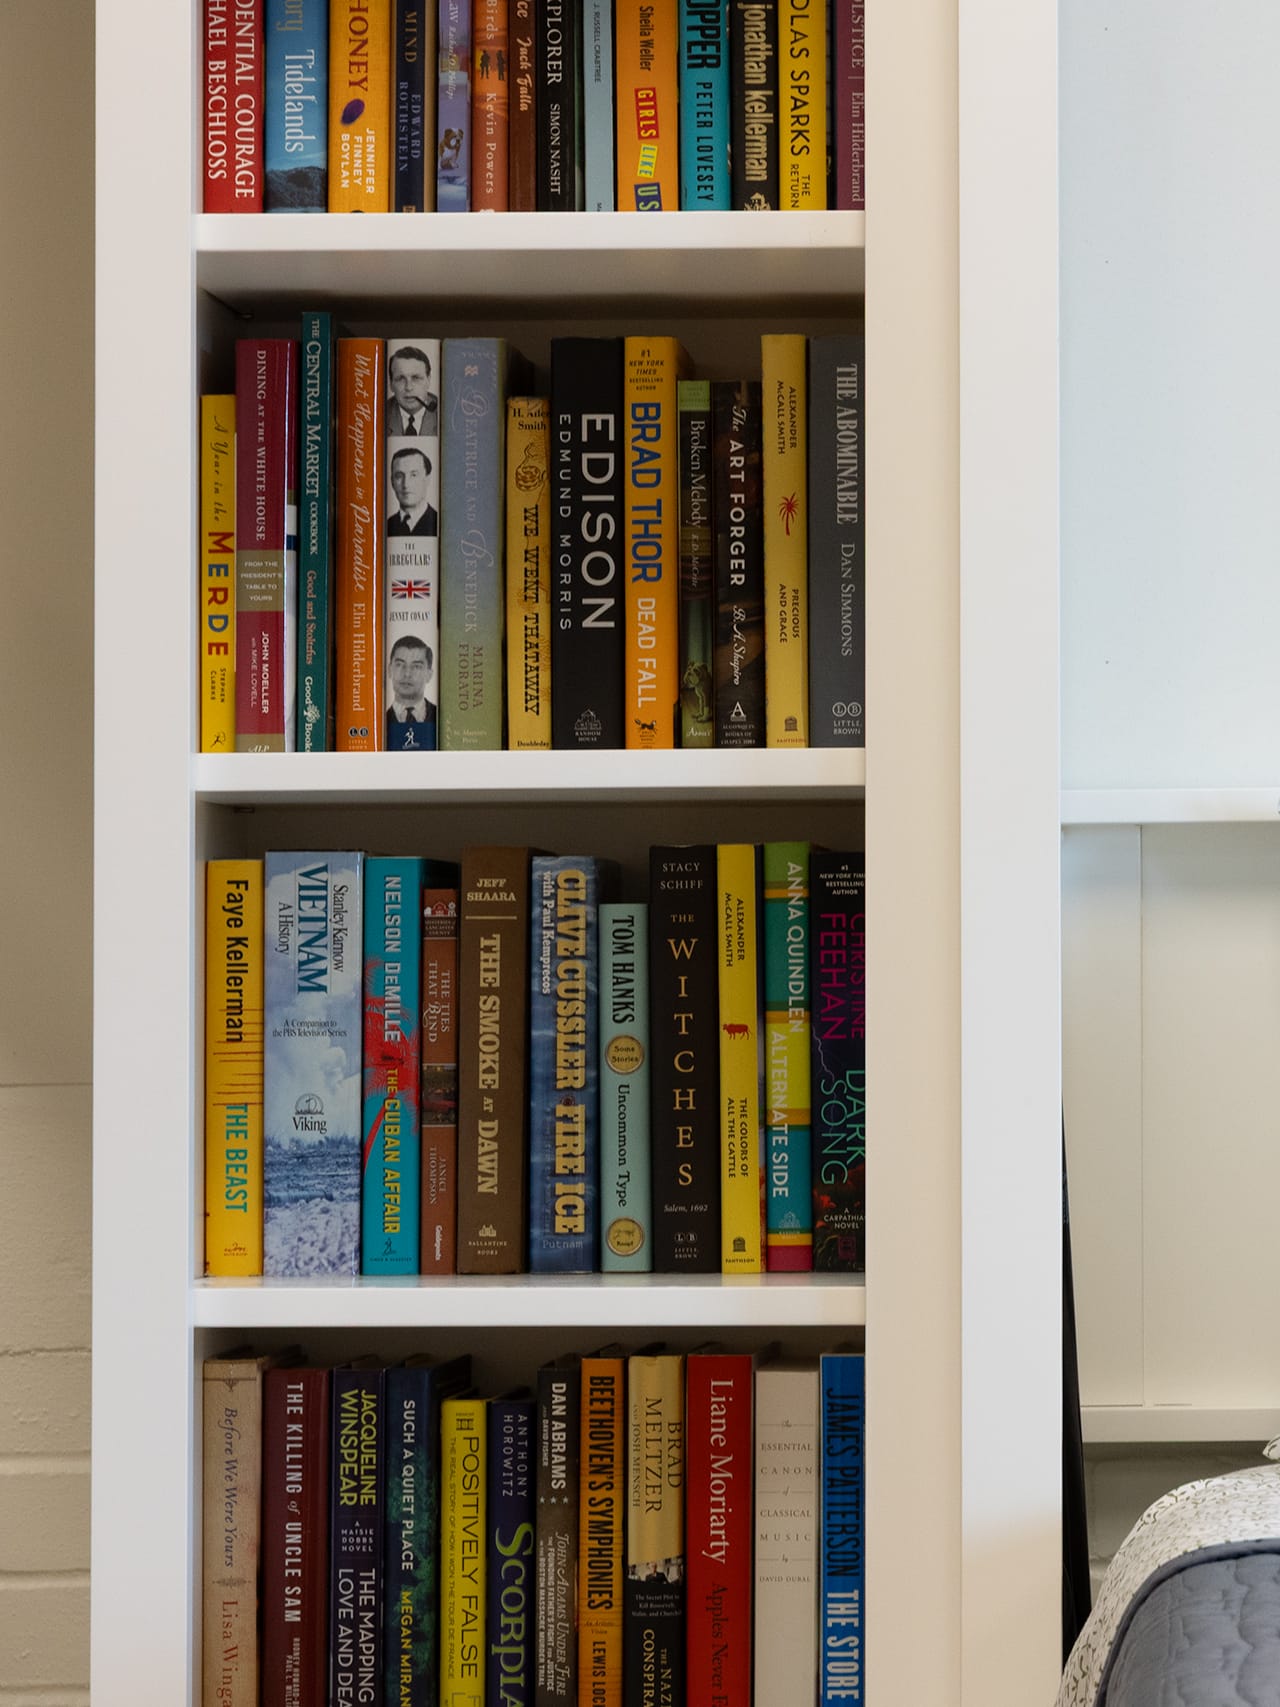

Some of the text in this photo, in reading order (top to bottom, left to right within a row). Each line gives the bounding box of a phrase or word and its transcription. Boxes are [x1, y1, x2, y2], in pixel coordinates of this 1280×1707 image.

[405, 11, 418, 63] MIND
[516, 37, 533, 111] Jack Falla
[208, 60, 227, 180] BESCHLOSS
[285, 49, 319, 153] Tidelands
[399, 81, 409, 172] ROTHSTEIN
[411, 94, 422, 159] EDWARD
[637, 6, 657, 177] Sheila Weller GIRLS LIKE
[737, 2, 774, 181] jonathan kellerman
[236, 94, 255, 198] COURAGE
[341, 133, 351, 189] BOYLAN
[353, 135, 364, 186] FINNEY
[366, 128, 376, 194] JENNIFER
[486, 93, 497, 194] Kevin Powers
[550, 103, 560, 195] SIMON NASHT
[696, 81, 714, 202] PETER LOVESEY
[790, 69, 811, 209] SPARKS THE RETURN
[851, 121, 865, 202] Hilderbrand
[256, 350, 266, 541] DINING WHITE HOUSE
[306, 340, 322, 497] CENTRAL MARKET
[630, 402, 661, 488] BRAD
[690, 420, 706, 471] Broken
[777, 421, 786, 454] SMITH
[836, 363, 858, 525] THE ABOMINABLE
[348, 353, 371, 711] What Happens Elin Hilderbrand
[559, 413, 572, 630] EDMUND MORRIS
[581, 414, 615, 628] EDISON
[630, 498, 662, 583] THOR
[686, 473, 706, 527] Melody
[306, 570, 316, 597] Good
[729, 405, 747, 685] The ART FORGER Shapiro
[523, 504, 540, 716] WE WENT THATAWAY
[637, 597, 656, 649] DEAD
[261, 663, 269, 714] MOELLER
[458, 643, 469, 712] FIORATO
[473, 646, 483, 708] MARINA
[637, 658, 656, 708] FALL
[466, 891, 516, 902] SHAARA
[477, 878, 506, 888] JEFF
[659, 880, 703, 889] SCHIFF
[662, 862, 700, 871] STACY
[275, 914, 293, 955] History
[297, 863, 328, 995] VIETNAM
[329, 884, 349, 972] Stanley Karnow
[385, 876, 401, 952] NELSON
[540, 870, 555, 994] with Paul Kemprecos
[725, 933, 733, 967] SMITH
[736, 898, 745, 961] ALEXANDER
[787, 861, 805, 1032] ANNA QUINDLEN
[222, 879, 249, 1043] Faye Kellerman
[428, 960, 437, 997] THAT
[441, 970, 450, 1032] THE TIES
[819, 913, 846, 1039] FEEHAN
[478, 933, 501, 1194] THE SMOKE DAWN
[555, 869, 586, 1233] CLIVE CUSSLER FIRE ICE
[611, 1056, 639, 1064] Stories
[611, 915, 635, 1207] TOM HANKS Uncommon Type
[613, 1045, 635, 1053] Some
[667, 938, 698, 1186] WITCHES
[293, 1117, 327, 1134] Viking
[739, 1121, 748, 1161] COLORS
[771, 1031, 788, 1198] ALTERNATE SIDE
[820, 1079, 848, 1185] SONG
[846, 1069, 865, 1166] DARK
[226, 1149, 248, 1213] BEAST
[384, 1098, 400, 1233] CUBAN AFFAIR
[690, 1204, 709, 1213] 1692
[340, 1388, 358, 1506] WINSPEAR
[360, 1389, 377, 1506] JACQUELINE
[502, 1414, 513, 1497] HOROWITZ
[517, 1413, 528, 1497] ANTHONY
[551, 1382, 567, 1490] DAN ABRAMS
[588, 1376, 615, 1491] BEETHOVEN'S
[645, 1396, 662, 1515] MELTZER
[667, 1421, 682, 1488] BRAD
[760, 1442, 813, 1452] ESSENTIAL
[760, 1467, 812, 1475] CANON
[218, 1407, 240, 1568] Before We Were Yours
[284, 1382, 303, 1622] THE KILLING UNCLE SAM
[401, 1399, 415, 1570] SUCH QUIET PLACE
[461, 1436, 480, 1584] POSITIVELY
[760, 1509, 812, 1518] CLASSICAL
[587, 1497, 614, 1610] SYMPHONIES
[702, 1378, 734, 1690] Liane Moriarty Apples Never
[760, 1533, 811, 1542] MUSIC
[825, 1387, 861, 1700] JAMES PATTERSON THE STORE
[222, 1600, 239, 1641] Lisa
[338, 1568, 354, 1667] LOVE AND
[358, 1567, 376, 1703] THE MAPPING
[400, 1591, 413, 1649] MEGAN
[460, 1595, 479, 1678] FALSE
[592, 1641, 606, 1677] LEWIS
